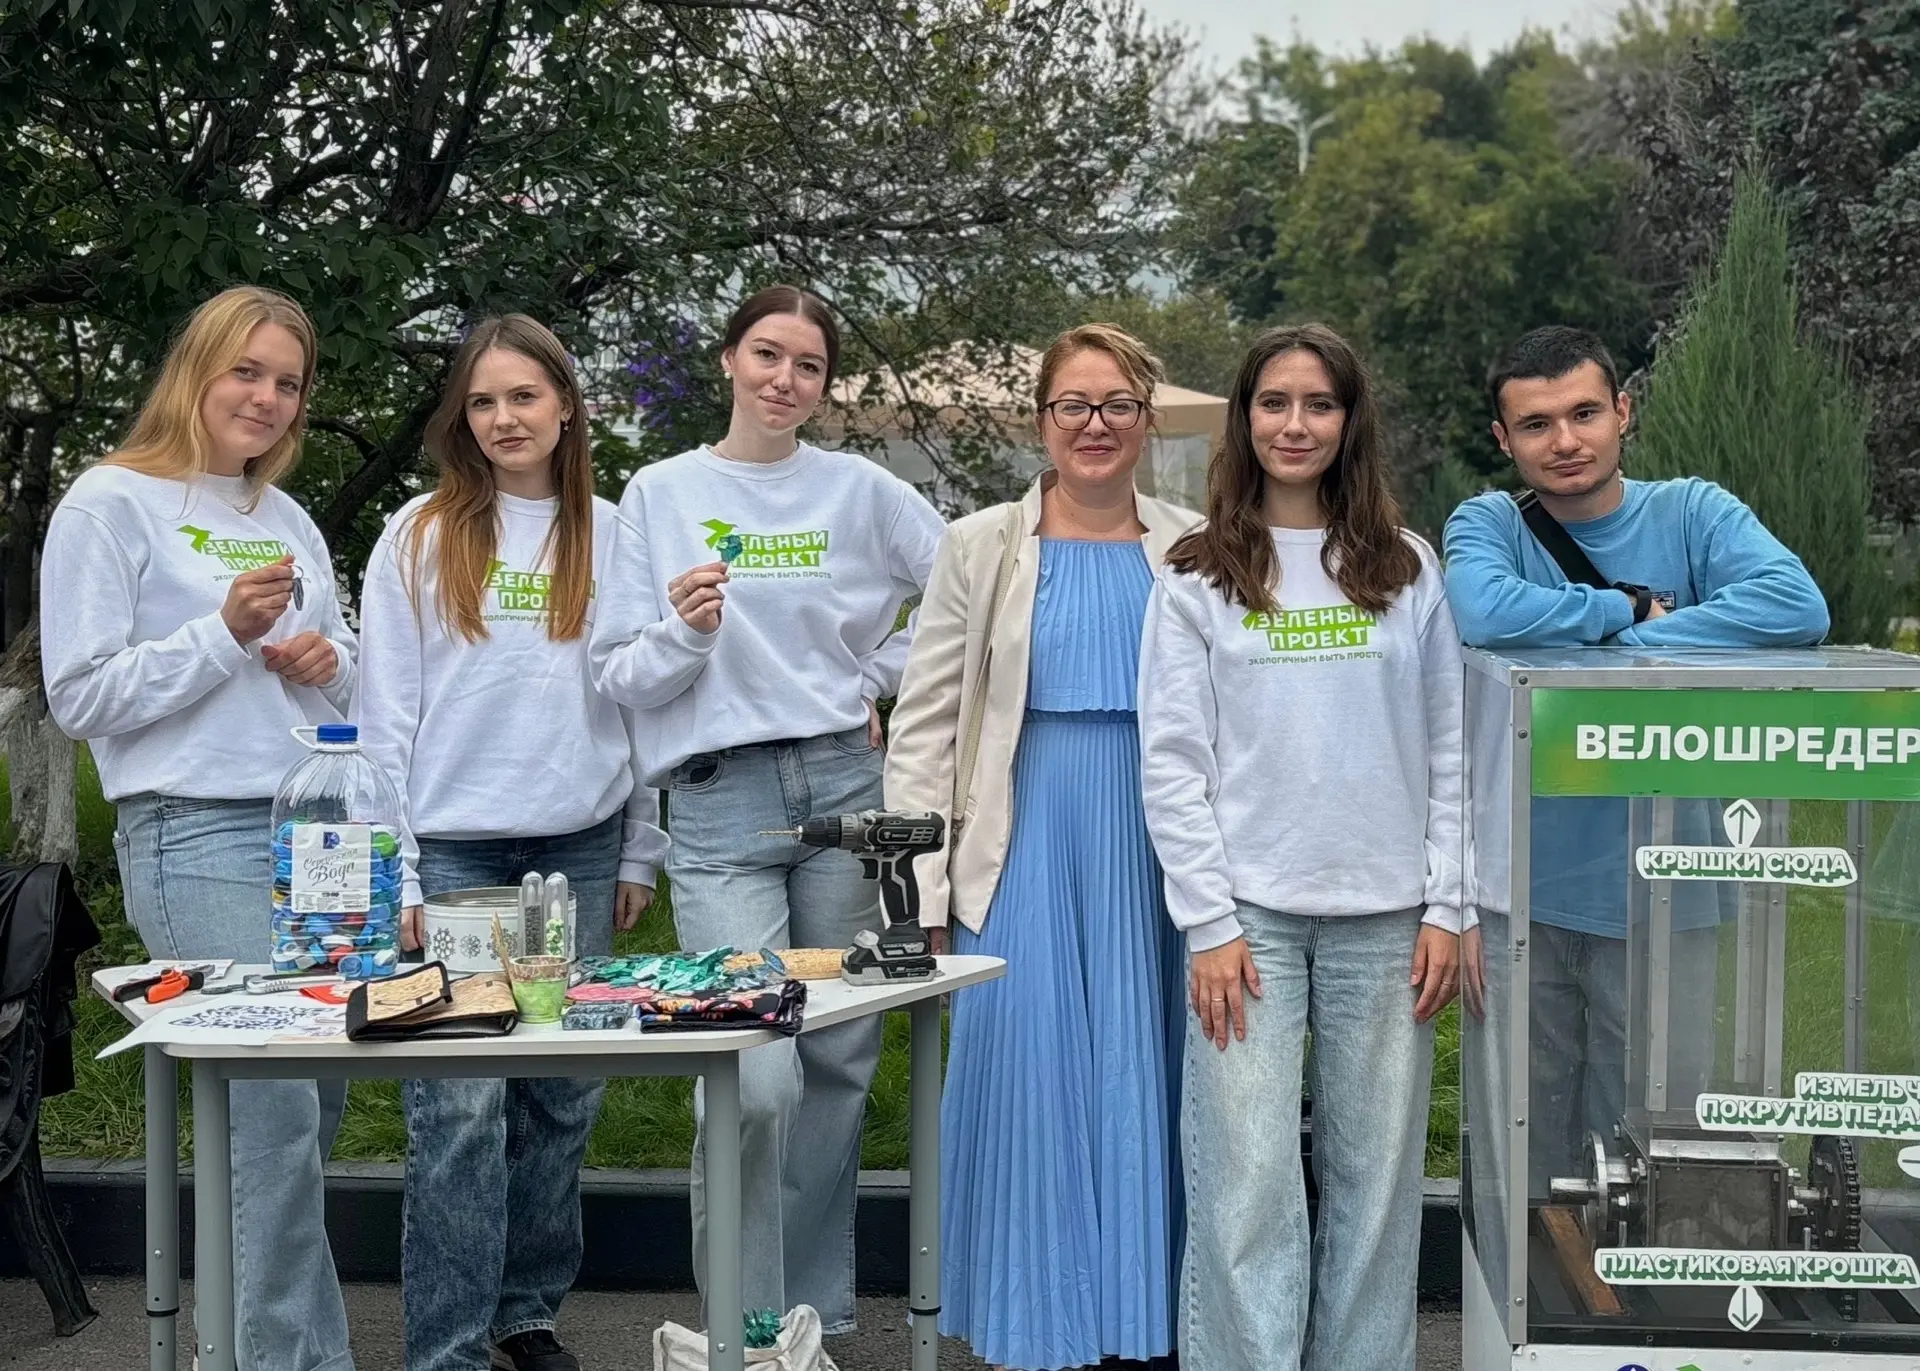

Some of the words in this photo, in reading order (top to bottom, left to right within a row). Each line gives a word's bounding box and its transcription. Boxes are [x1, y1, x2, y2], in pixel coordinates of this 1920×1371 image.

[719, 531, 826, 551] ЕЛЕНЫЙ
[1270, 626, 1366, 650] ПРОЕКТ
[1247, 655, 1317, 666] ЭКОЛОГИЧНЫМ
[1319, 653, 1346, 662] БЫТЬ
[1347, 651, 1384, 660] ПРОСТО
[1576, 724, 1920, 771] ВЕЛОШРЕДЕР
[1643, 850, 1761, 876] КРЫШКИ
[1765, 852, 1850, 880] СЮДА
[1701, 1098, 1841, 1126] ПОКРУТИВ
[1844, 1104, 1920, 1132] ПЕДА
[1600, 1253, 1793, 1279] ПЛАСТИКОВАЯ
[1795, 1256, 1914, 1282] КРОШКА
